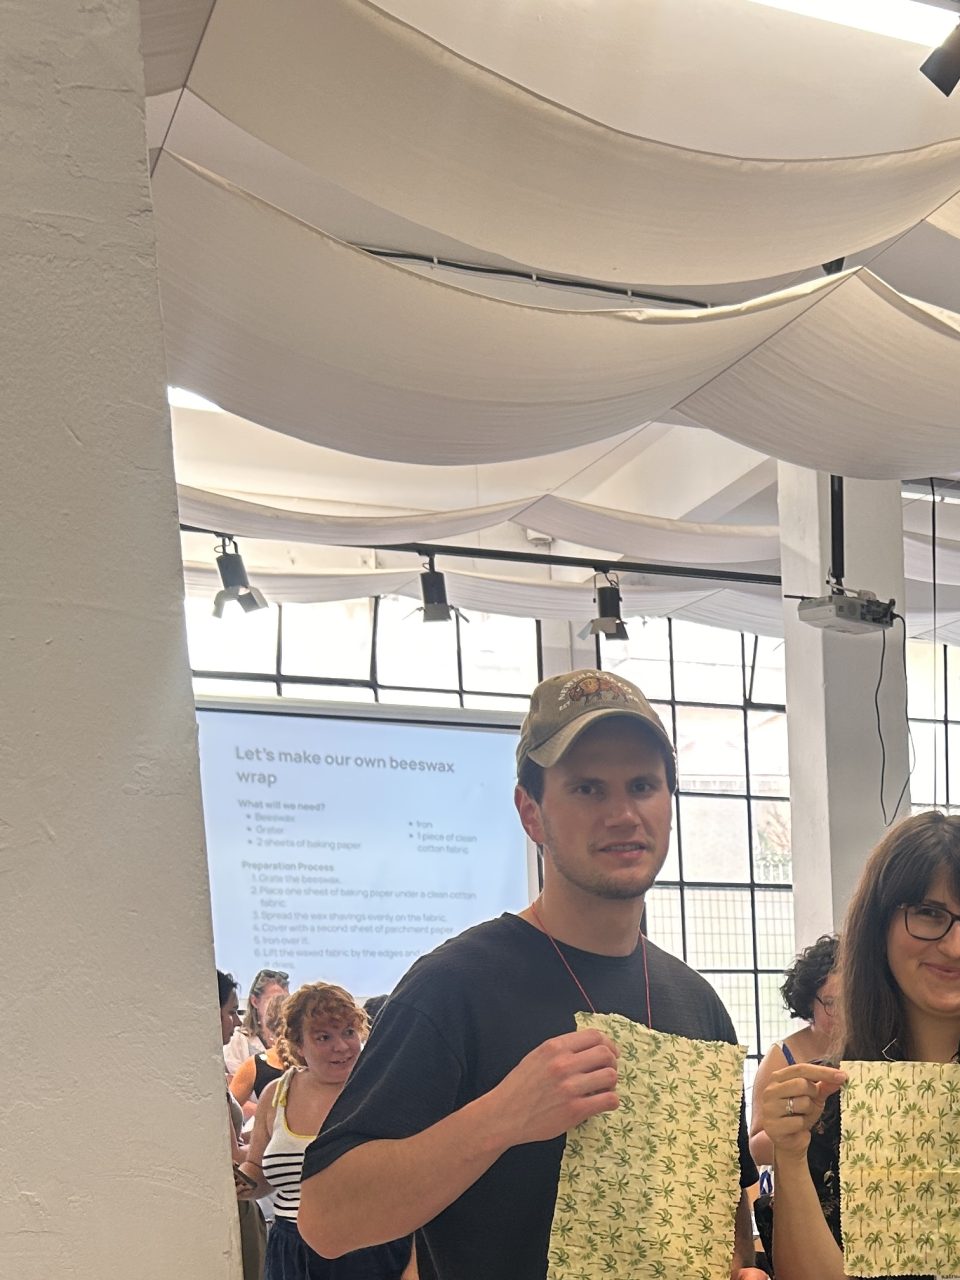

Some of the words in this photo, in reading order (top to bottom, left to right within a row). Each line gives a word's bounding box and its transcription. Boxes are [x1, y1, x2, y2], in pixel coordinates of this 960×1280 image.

[235, 745, 275, 761] Let's
[279, 749, 321, 764] make
[324, 754, 350, 766] our
[354, 756, 386, 768] own
[389, 755, 454, 773] beeswax
[236, 771, 277, 788] wrap
[238, 799, 263, 809] What
[265, 800, 280, 809] will
[297, 802, 326, 811] need?
[422, 832, 444, 843] piece
[446, 832, 455, 841] of
[257, 838, 263, 847] 2
[264, 838, 295, 848] sheets
[296, 838, 305, 848] of
[307, 839, 335, 851] baking
[337, 841, 361, 851] paper
[241, 861, 296, 871] Preparation
[298, 862, 334, 872] Process
[285, 875, 300, 884] the
[259, 885, 283, 896] Place
[285, 887, 302, 896] one
[303, 887, 328, 897] sheet
[330, 888, 339, 897] of
[369, 889, 393, 900] paper
[395, 889, 419, 899] under
[261, 910, 292, 922] Spread
[294, 911, 309, 920] the
[407, 912, 421, 921] the
[262, 923, 288, 933] Cover
[289, 923, 309, 933] with
[349, 924, 373, 934] sheet
[375, 924, 384, 934] of
[350, 948, 361, 960] by
[362, 948, 376, 958] the
[377, 948, 402, 960] edges
